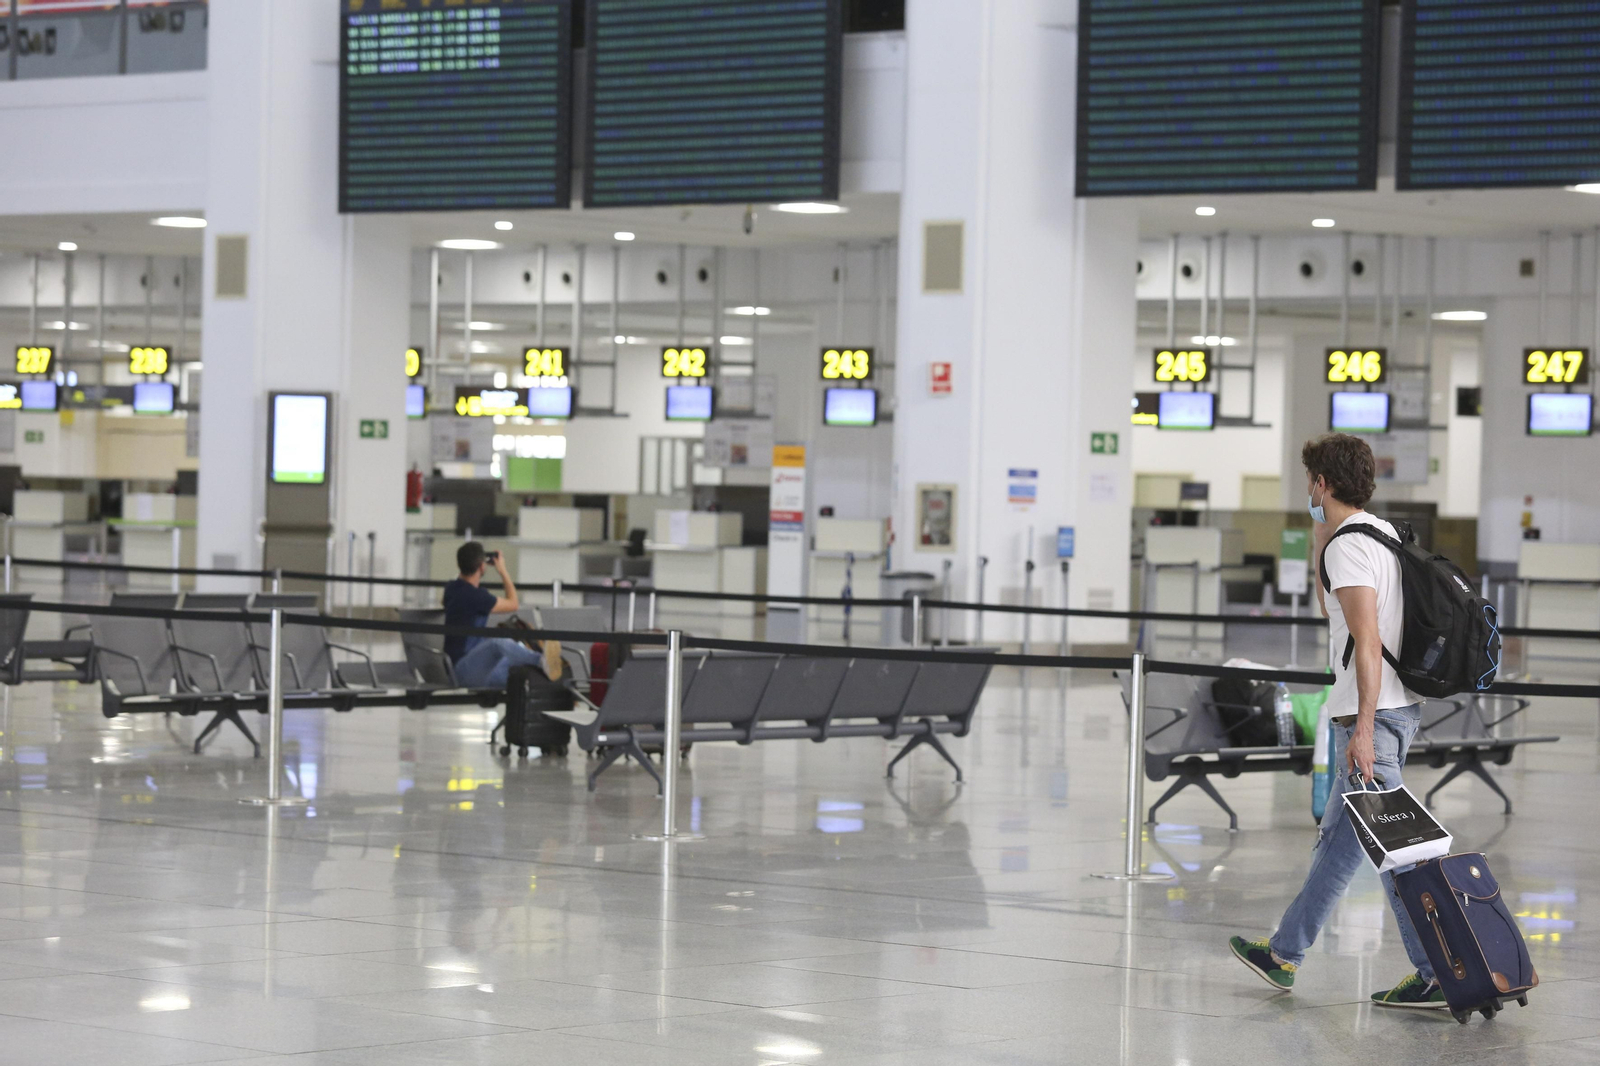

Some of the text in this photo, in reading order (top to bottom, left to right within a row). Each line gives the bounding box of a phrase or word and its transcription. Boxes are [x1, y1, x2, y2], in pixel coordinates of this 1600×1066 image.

[525, 349, 564, 376] 241
[664, 349, 706, 377] 242
[823, 350, 869, 379] 243
[1156, 351, 1207, 382] 245
[1328, 350, 1381, 382] 246
[1527, 351, 1583, 382] 247
